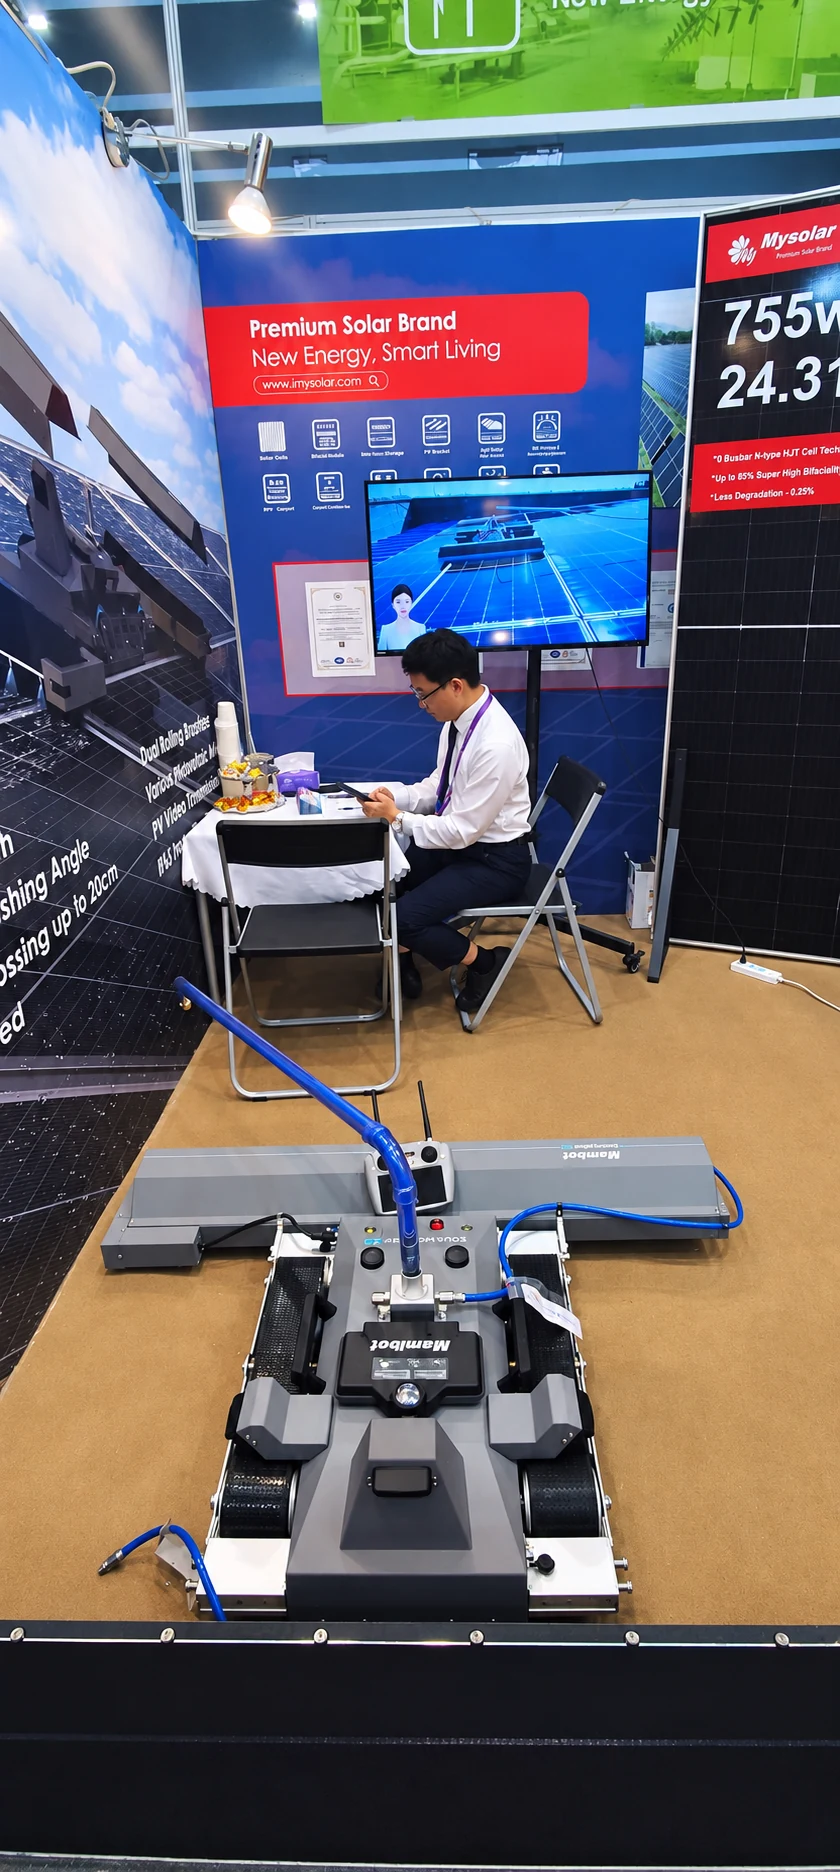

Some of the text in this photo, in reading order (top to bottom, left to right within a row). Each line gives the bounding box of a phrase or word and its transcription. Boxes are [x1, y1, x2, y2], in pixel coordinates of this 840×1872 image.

[760, 224, 838, 250] Mysolar
[816, 244, 832, 252] Brand
[250, 310, 456, 338] Premium Solar Brand
[252, 338, 500, 368] New Energy, Smart Living
[262, 376, 362, 390] www.imysolar.com
[724, 452, 752, 463] Busbar
[754, 450, 781, 460] N-type
[783, 448, 800, 458] HJT
[802, 446, 818, 456] Cell
[738, 472, 754, 480] 85%
[756, 470, 780, 480] Super
[782, 468, 800, 478] High
[734, 490, 783, 501] Degradation
[790, 486, 814, 496] 0.25%
[140, 742, 159, 767] Dual
[158, 728, 184, 759] Rolling
[145, 771, 173, 804] Various
[152, 812, 164, 841] PV
[164, 798, 186, 829] Video
[0, 838, 90, 922] shing Angle
[52, 908, 72, 936] up
[73, 894, 86, 918] to
[88, 864, 119, 905] 20cm
